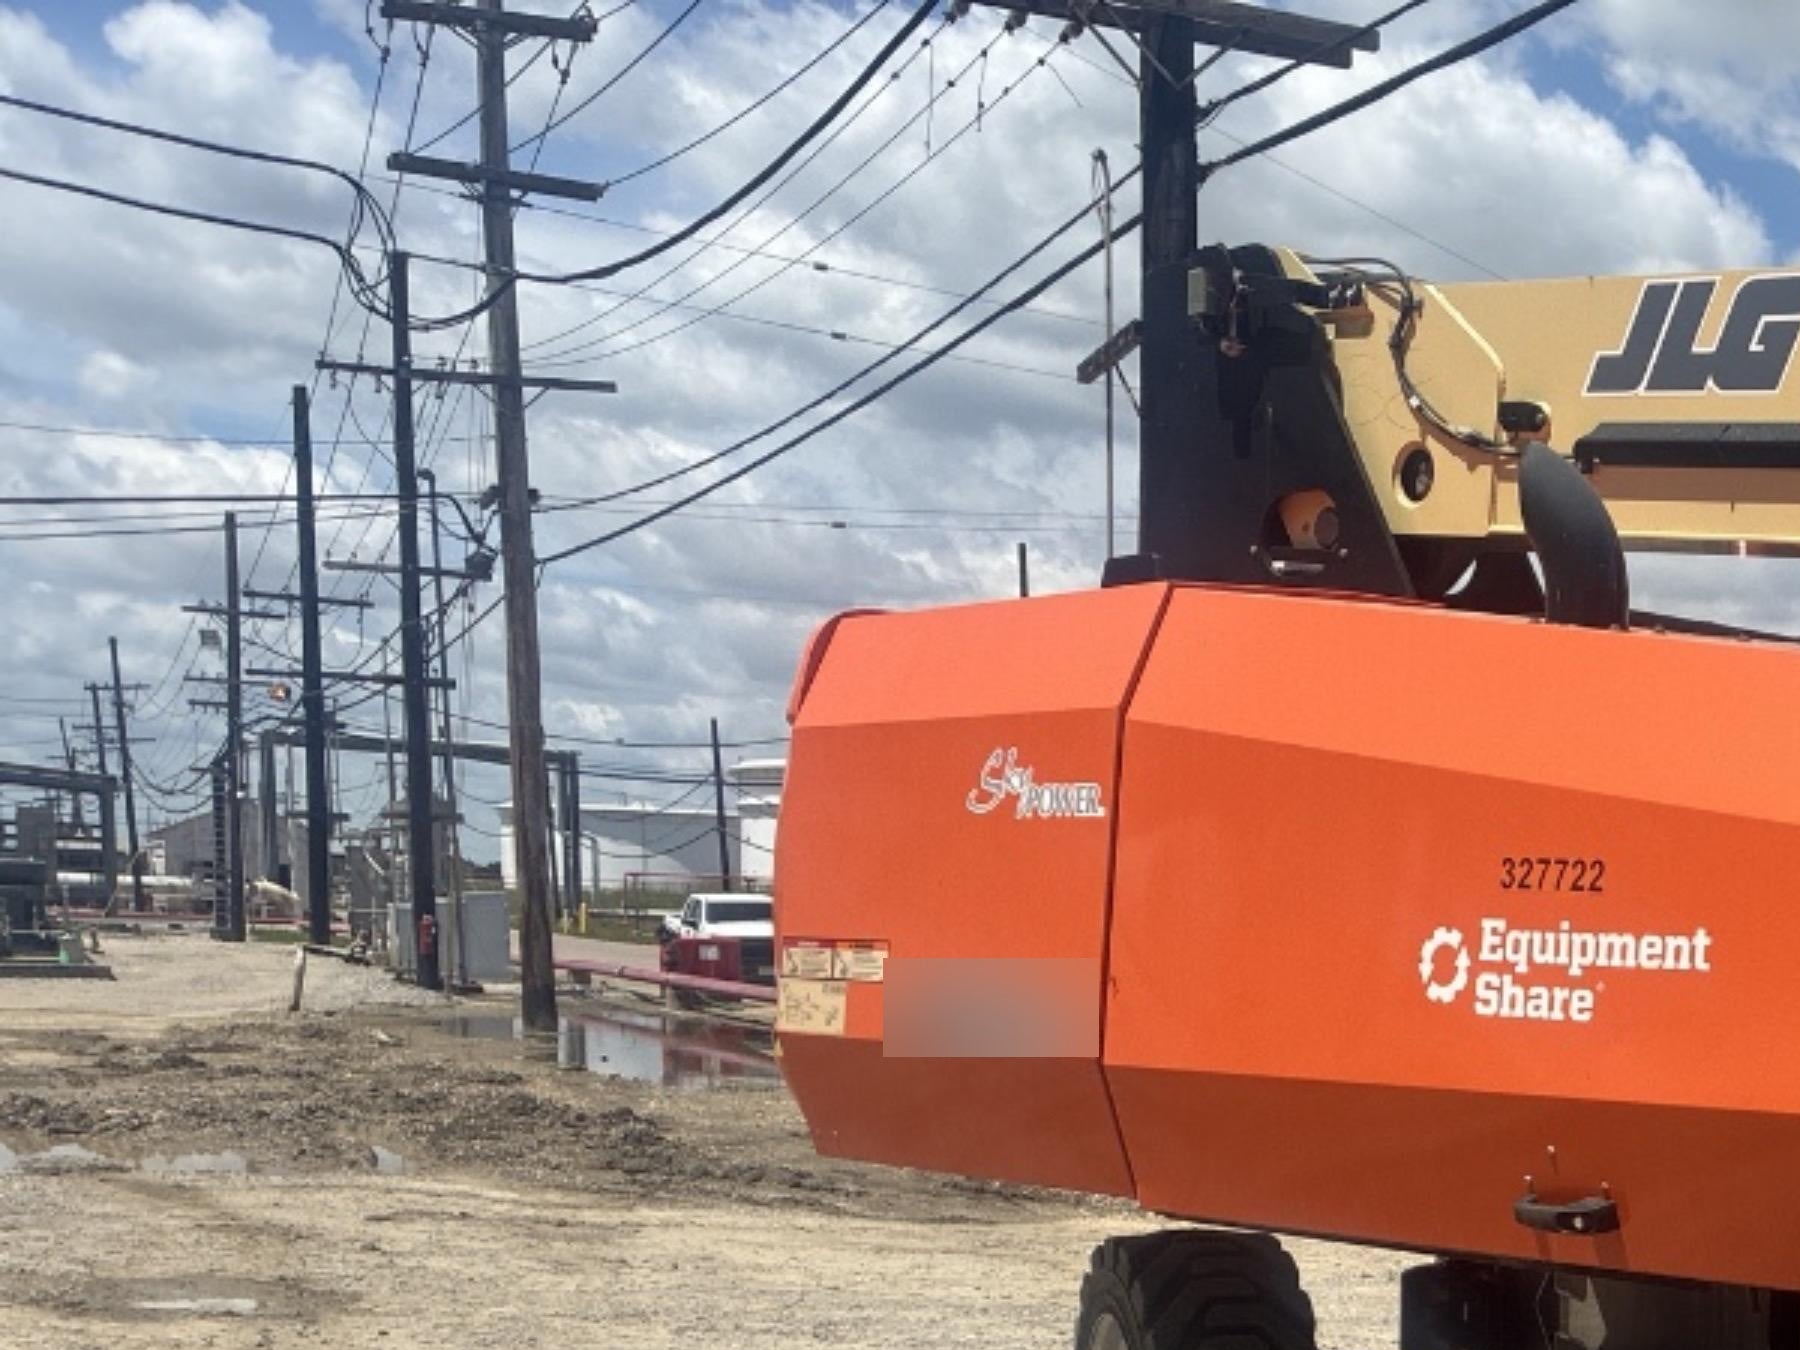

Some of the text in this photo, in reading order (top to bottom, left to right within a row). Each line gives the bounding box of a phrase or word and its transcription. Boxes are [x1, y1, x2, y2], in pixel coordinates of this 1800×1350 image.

[1500, 857, 1607, 893] 327722
[1478, 917, 1713, 976] Equipment
[1474, 972, 1596, 1022] Share
